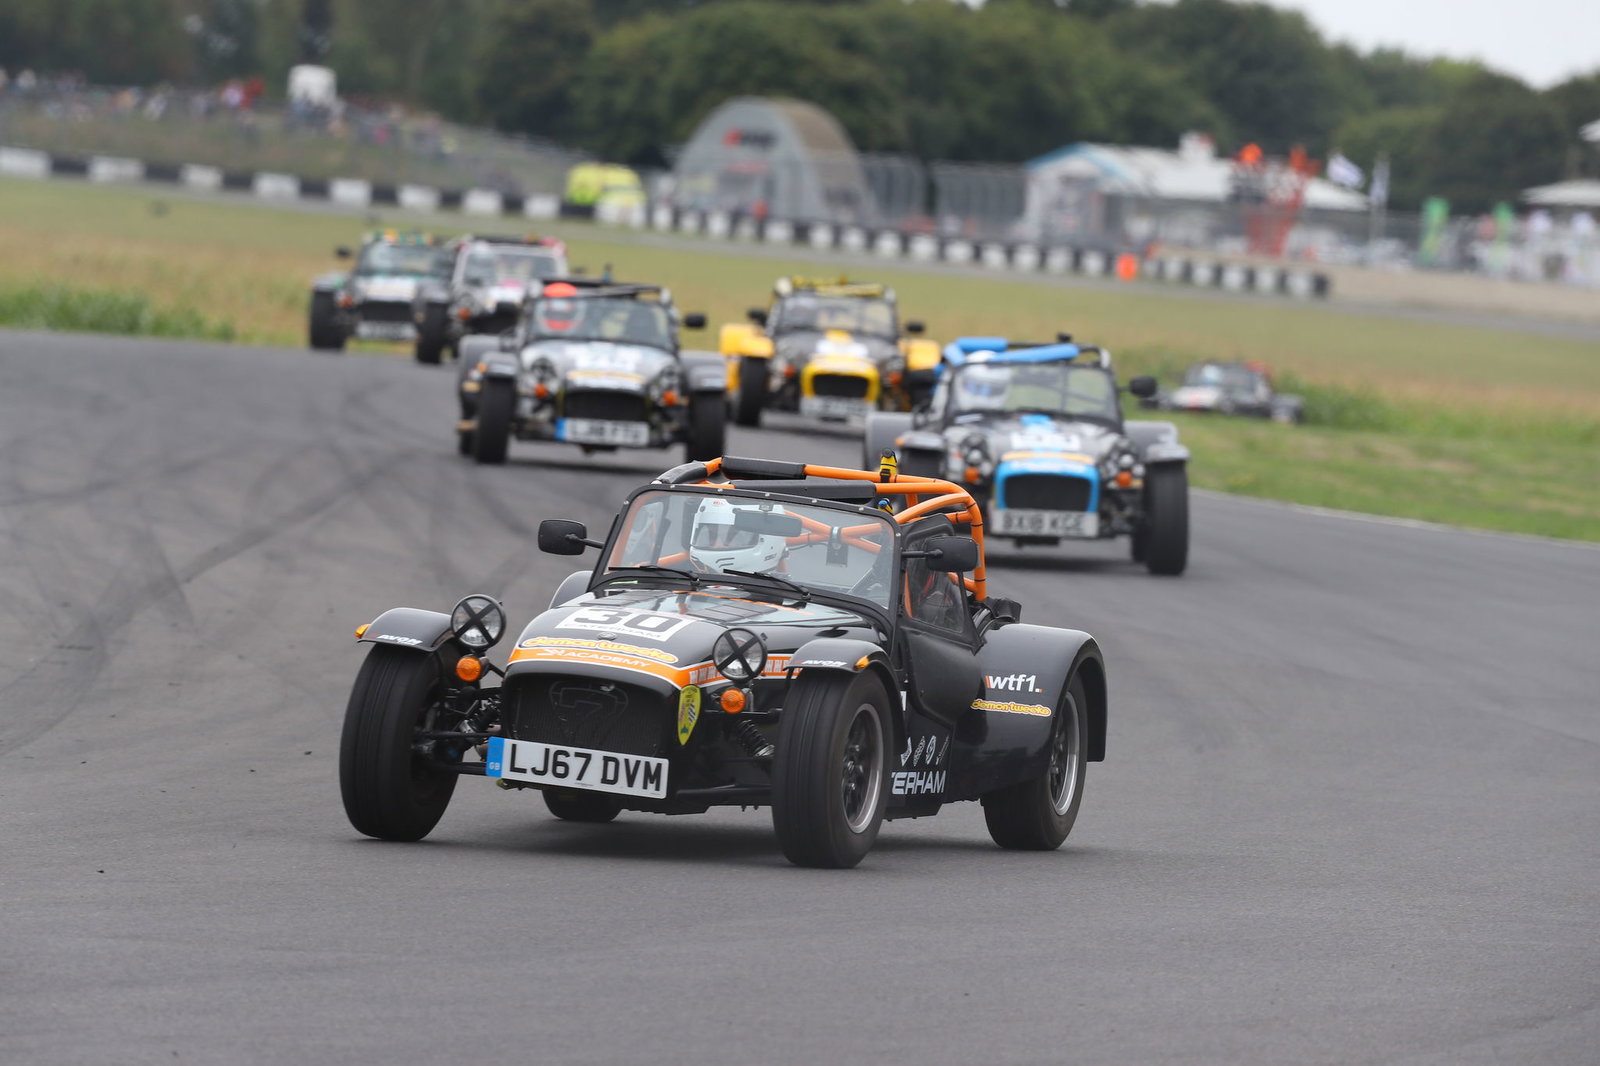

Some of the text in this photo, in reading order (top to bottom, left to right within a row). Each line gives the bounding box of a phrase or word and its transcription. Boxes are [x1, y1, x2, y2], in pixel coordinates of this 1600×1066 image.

[573, 608, 684, 632] 30
[564, 650, 651, 668] ACADEMY
[971, 700, 1051, 716] demon tweeks
[508, 743, 663, 792] LJ67 DVM
